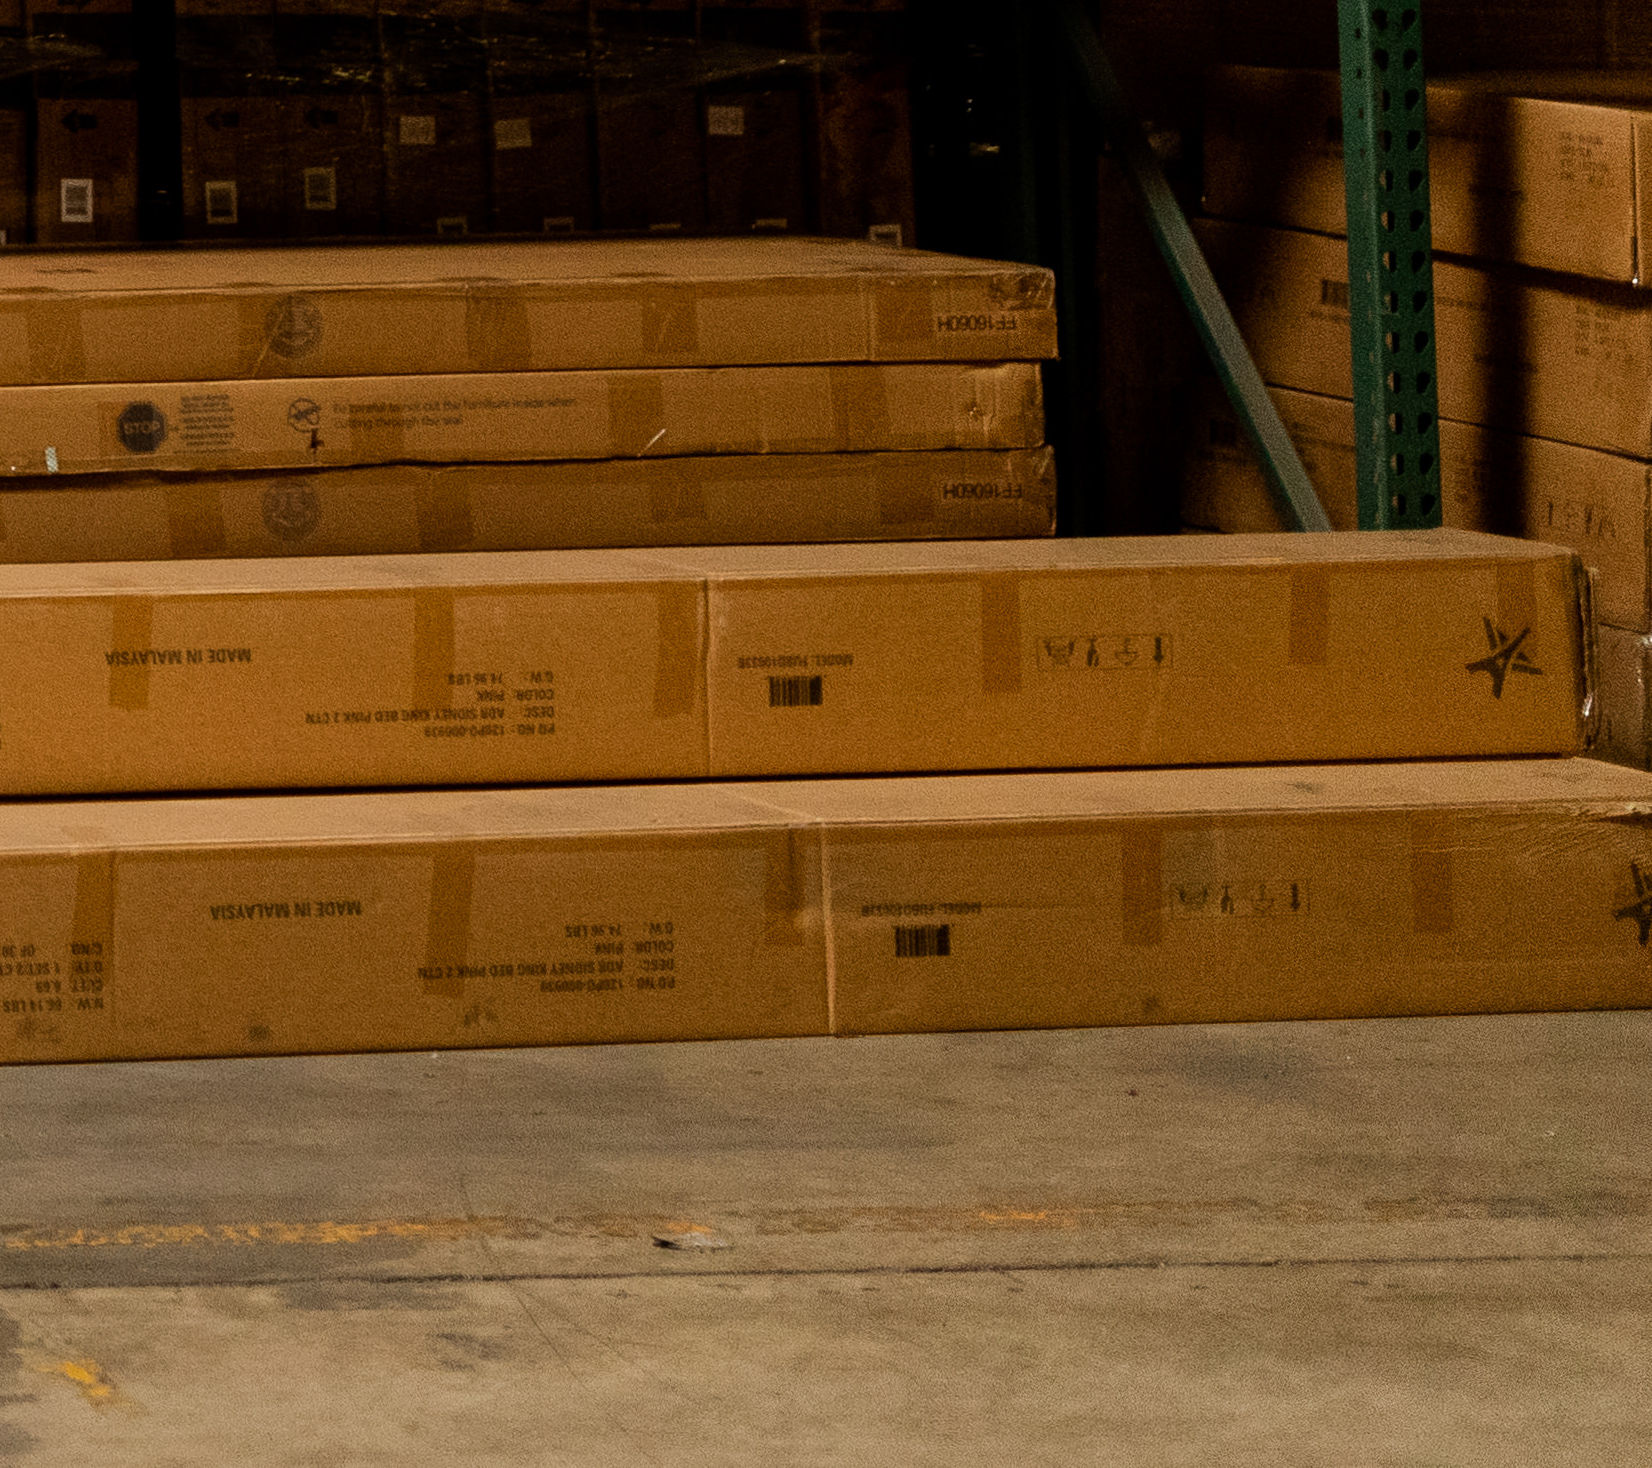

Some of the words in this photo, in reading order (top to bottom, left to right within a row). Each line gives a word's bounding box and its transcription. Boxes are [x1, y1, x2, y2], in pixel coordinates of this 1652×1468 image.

[105, 649, 183, 666] MALAYSIA
[186, 649, 203, 664] IN
[207, 648, 252, 663] MADE
[210, 903, 291, 920] MALAYSIA
[294, 902, 312, 918] IN
[320, 900, 363, 916] MADE
